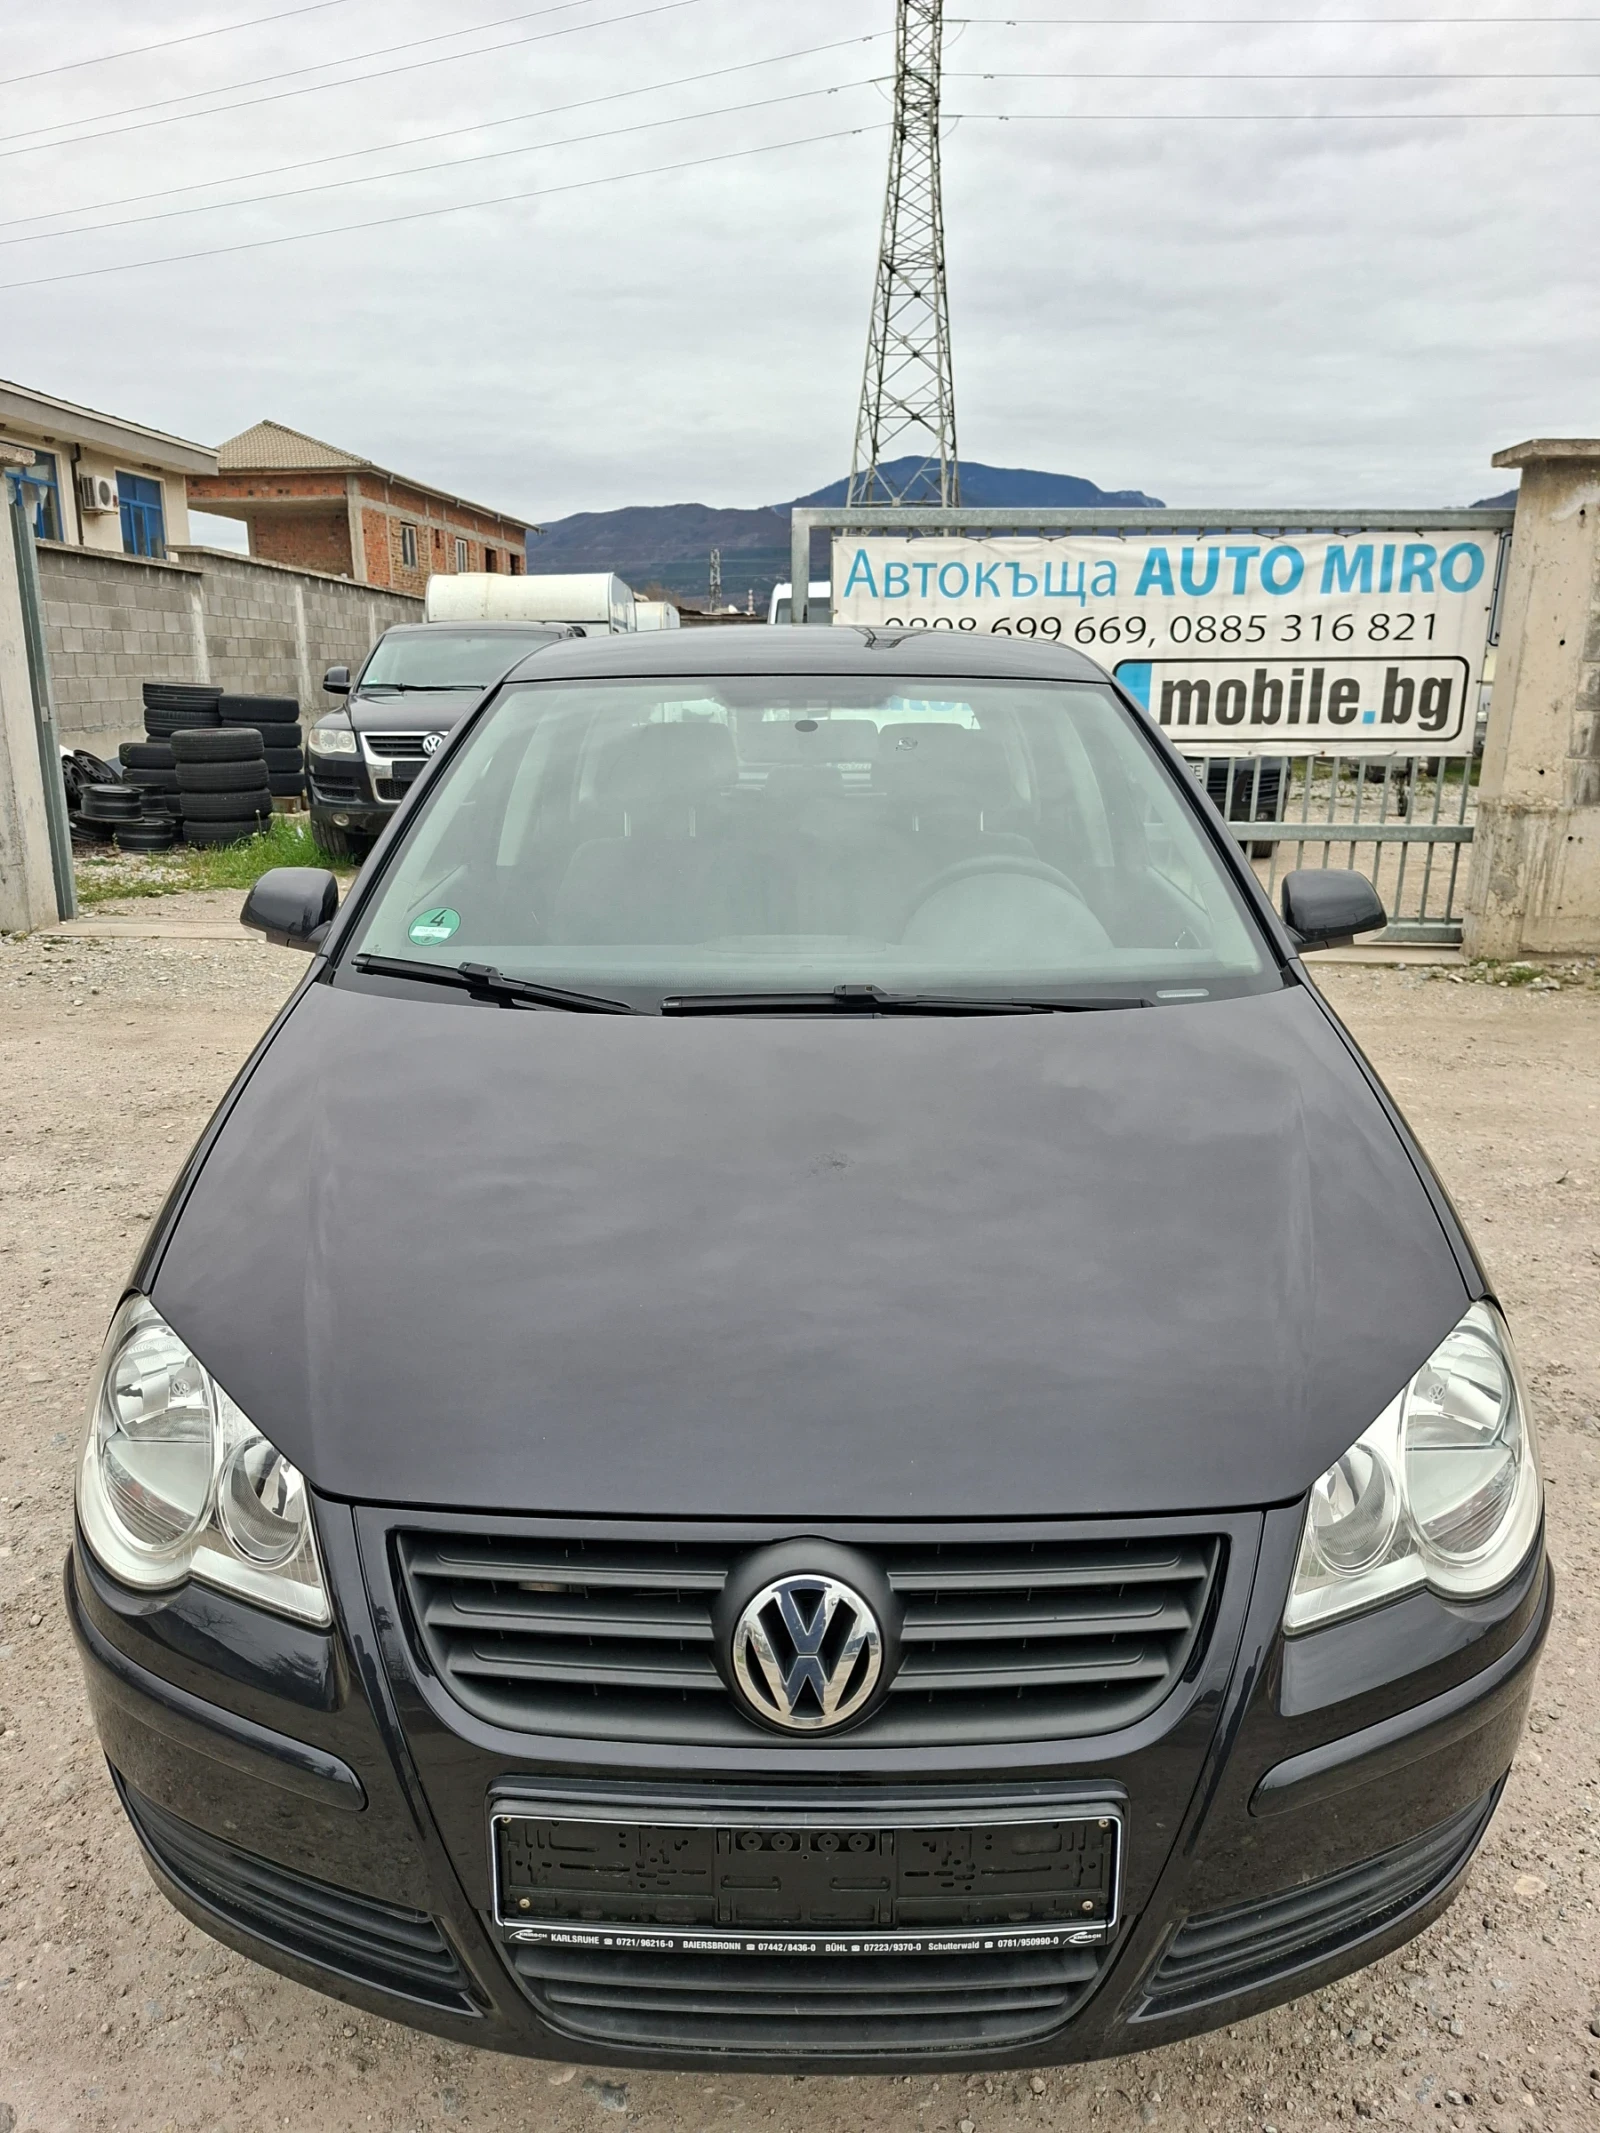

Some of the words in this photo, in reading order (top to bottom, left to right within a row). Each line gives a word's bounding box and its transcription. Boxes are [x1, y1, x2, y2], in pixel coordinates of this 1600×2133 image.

[843, 548, 1117, 607] Автокъща
[1134, 545, 1305, 597] AUTO
[1319, 542, 1485, 594] MIRO
[1074, 616, 1155, 648] 669,
[1169, 615, 1268, 643] 0885
[1281, 614, 1355, 642] 316
[1367, 613, 1436, 641] 821
[1159, 667, 1453, 732] mobile.bg
[430, 909, 447, 926] 4
[550, 1933, 600, 1945] KARLSRUHE
[616, 1938, 674, 1948] 0721/96216-0
[682, 1940, 741, 1950] BAIERSBRONN
[758, 1942, 816, 1952] 07442/8436-0
[825, 1942, 848, 1952] BÜHL
[863, 1942, 922, 1952] 07223/9370-0
[928, 1941, 980, 1951] Schutterwald
[997, 1936, 1060, 1948] 0781/950990-0
